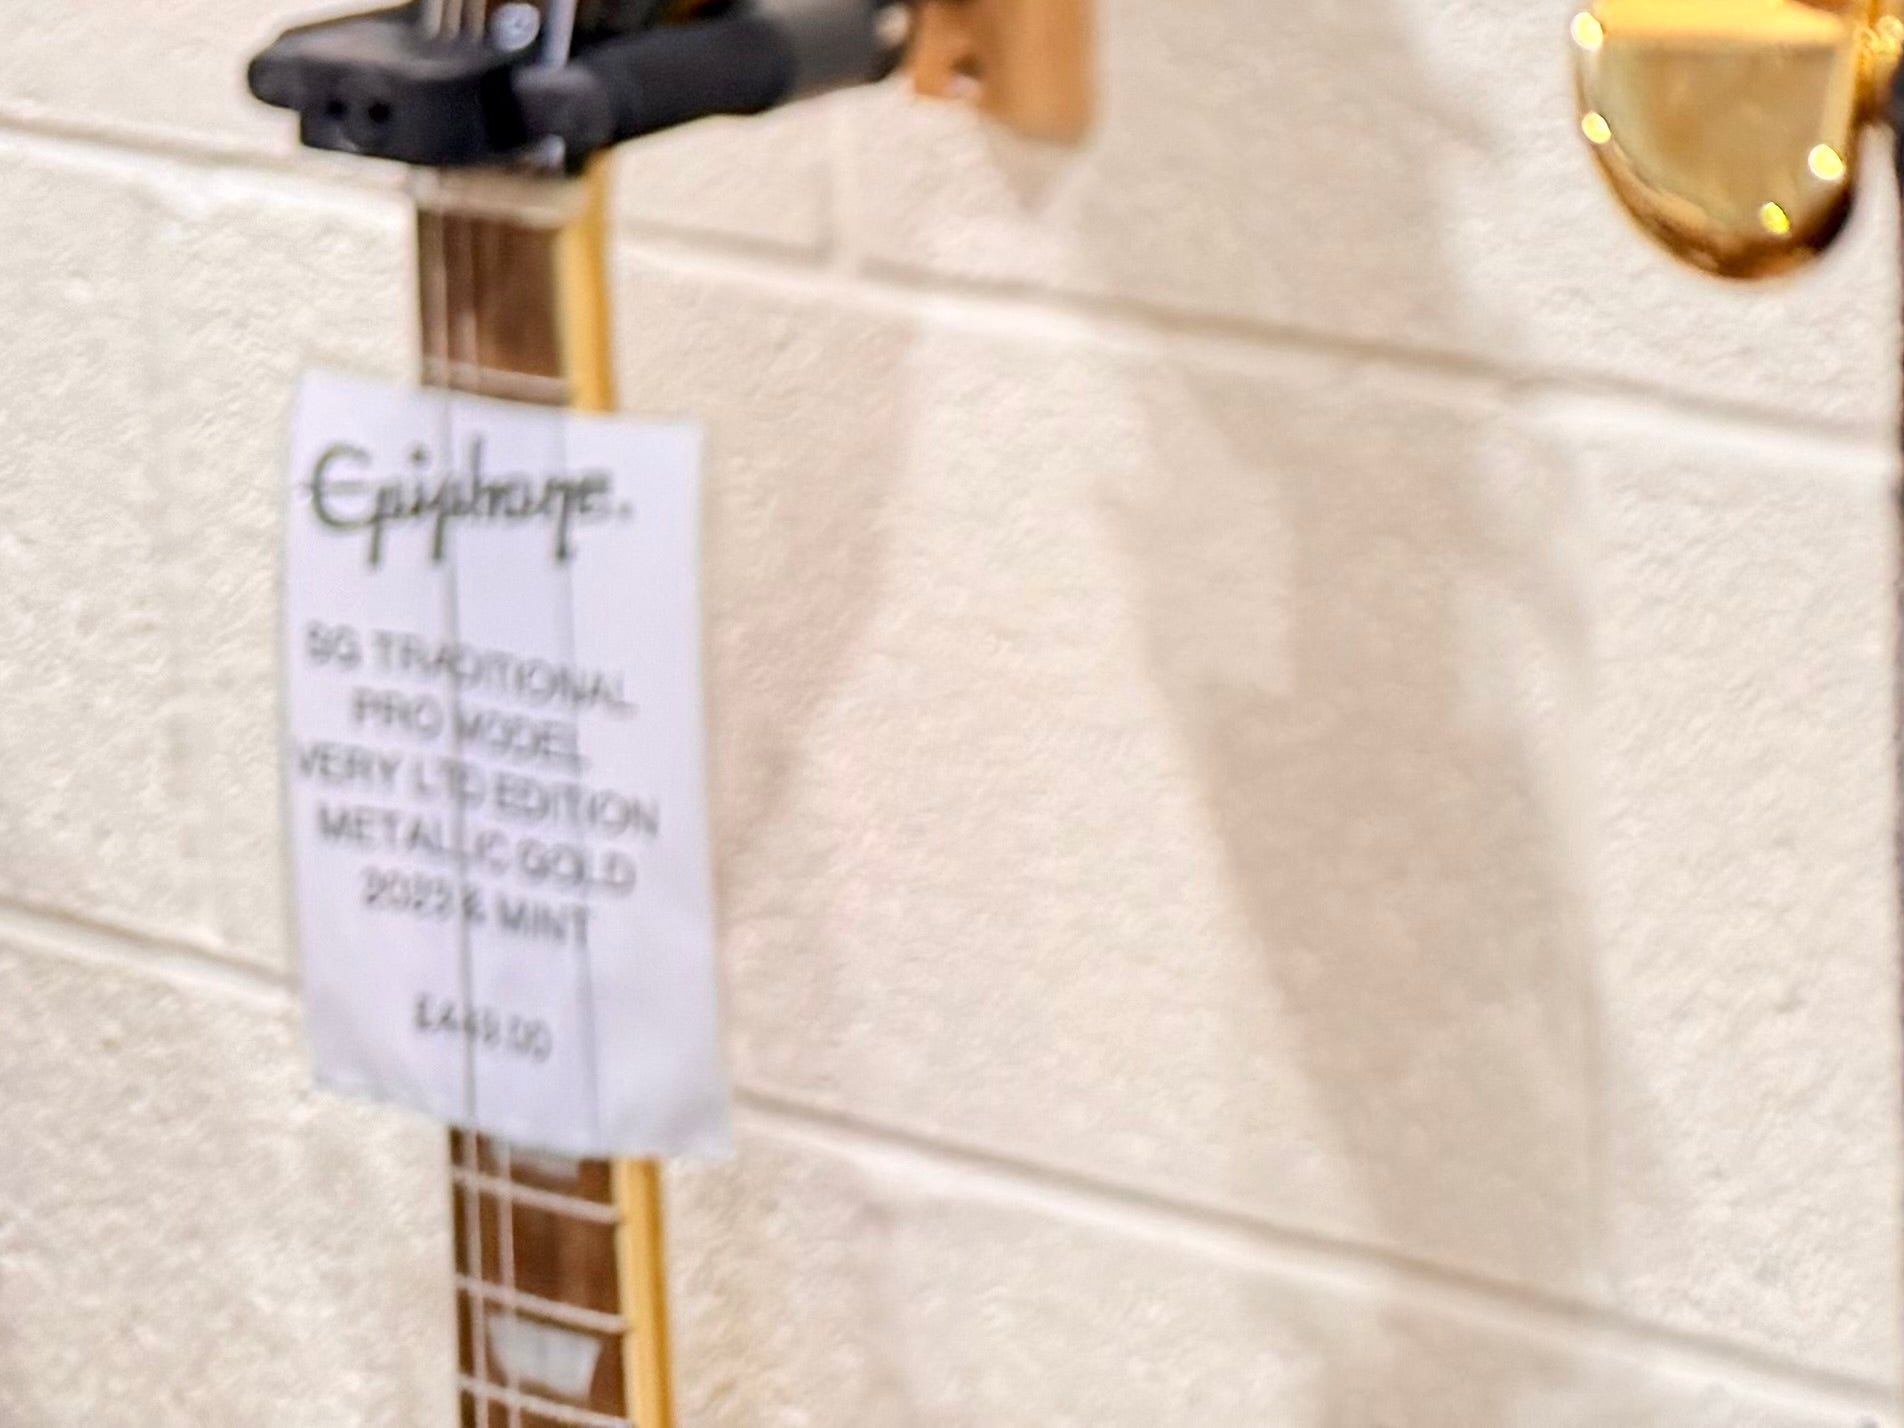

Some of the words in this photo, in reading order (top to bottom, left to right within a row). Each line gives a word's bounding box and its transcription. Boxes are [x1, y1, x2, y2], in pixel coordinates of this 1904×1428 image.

[371, 628, 640, 719] TRADITIONAL
[350, 685, 443, 741] PRO
[452, 705, 592, 777] MODEL
[297, 740, 401, 786] VERY
[494, 771, 662, 840] EDITION
[516, 836, 638, 898] GOLD
[496, 893, 592, 950] MINT
